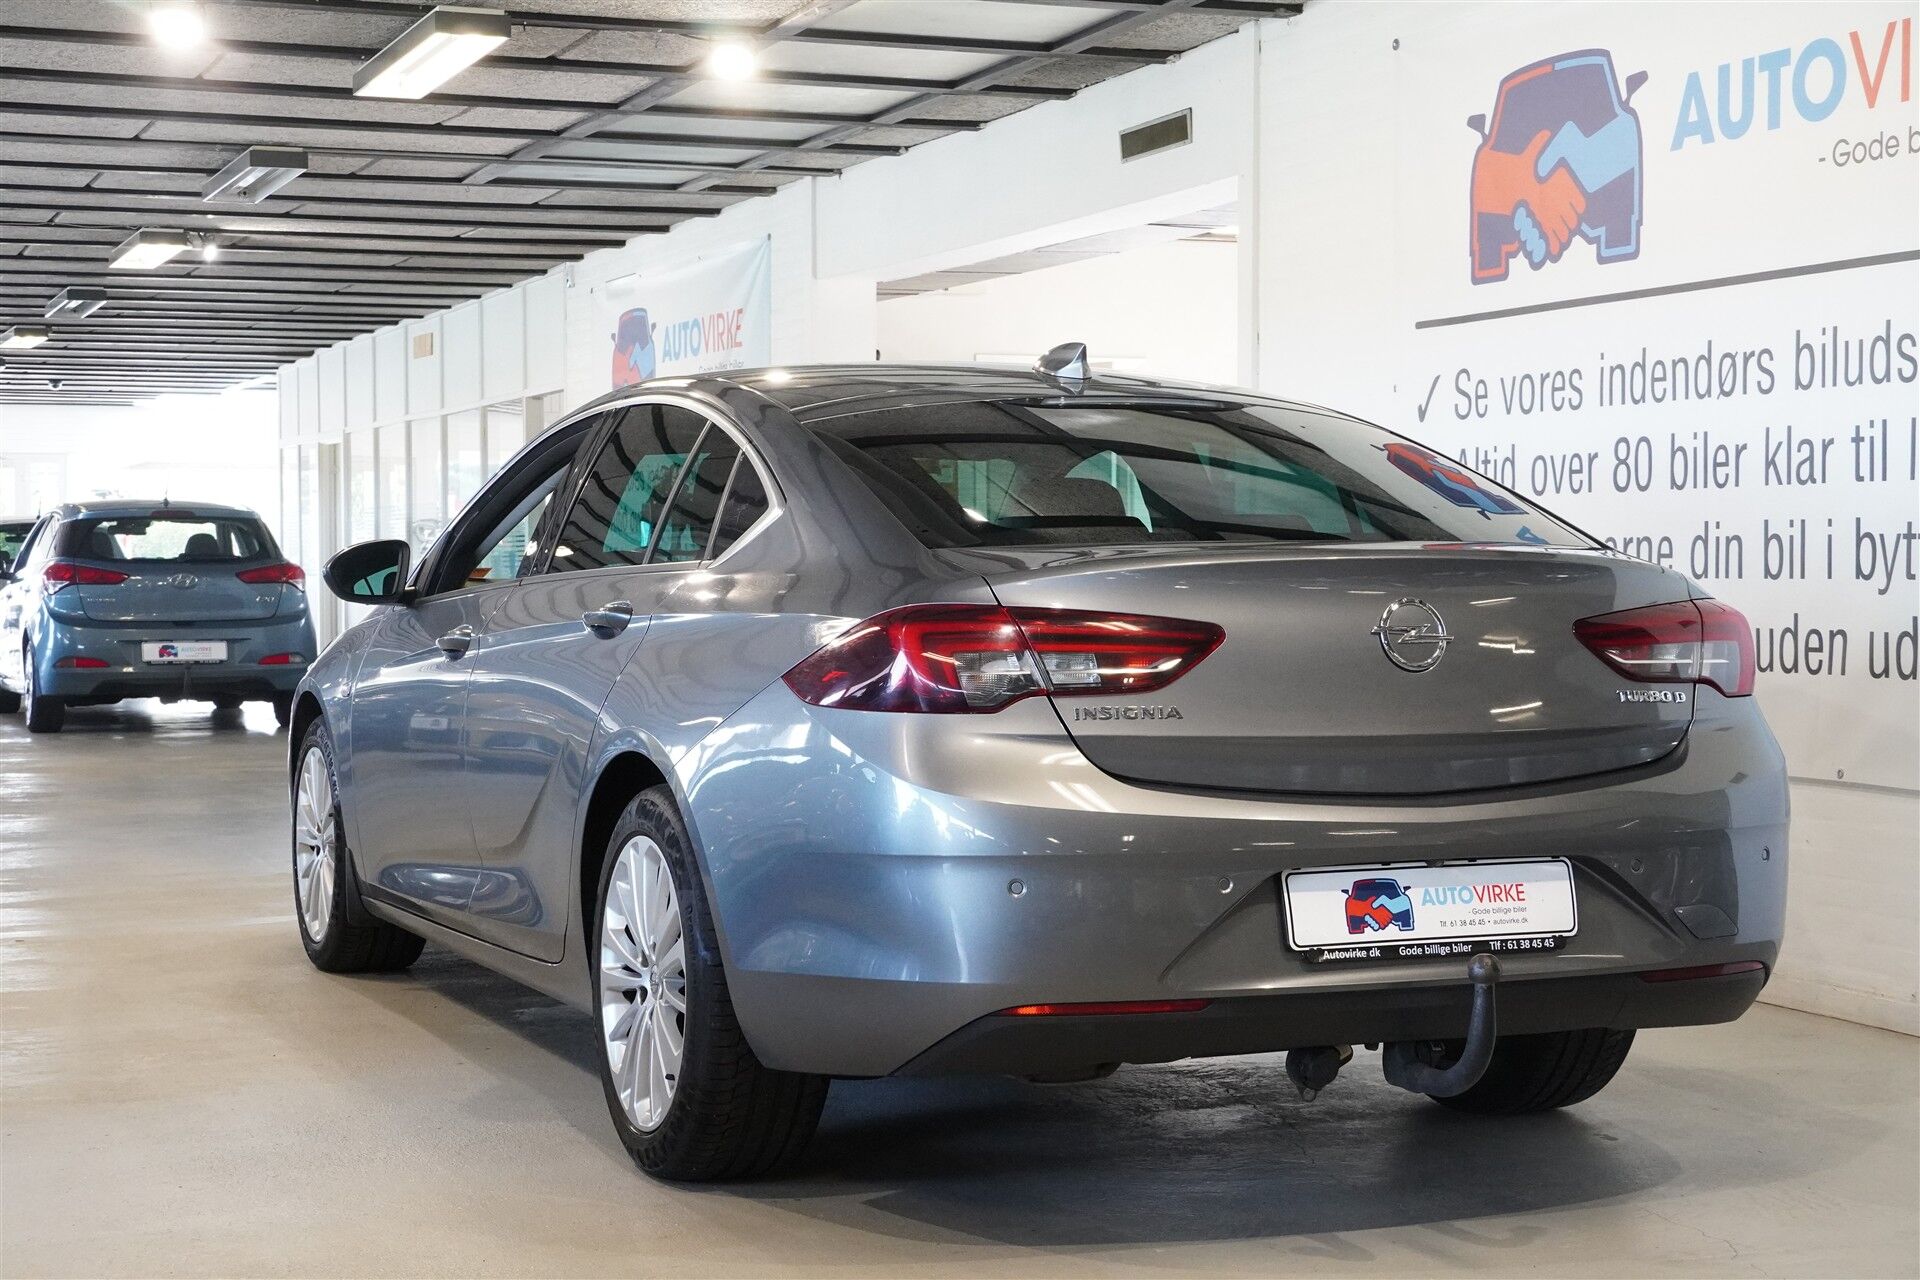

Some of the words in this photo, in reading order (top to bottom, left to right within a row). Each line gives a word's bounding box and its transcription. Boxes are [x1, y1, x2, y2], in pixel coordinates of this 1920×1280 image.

[1670, 17, 1911, 151] AUTOVI
[1832, 131, 1900, 167] Gode
[662, 308, 743, 363] AUTOVIRKE
[1454, 368, 1488, 420] Se
[1500, 368, 1583, 415] vores
[1599, 340, 1775, 406] indendørs
[1794, 319, 1918, 391] biluds
[1531, 451, 1598, 496] over
[1613, 436, 1653, 493] 80
[1670, 431, 1747, 491] biler
[1764, 425, 1834, 487] klar
[1850, 419, 1888, 483] til
[1690, 520, 1743, 580] din
[1763, 519, 1806, 580] bil
[1827, 518, 1833, 580] i
[1855, 517, 1920, 595] byt
[1756, 613, 1848, 676] uden
[1868, 616, 1918, 680] ud
[1074, 705, 1184, 721] INSIGNIA
[1616, 690, 1672, 703] TURBO
[1674, 691, 1687, 703] D
[1421, 883, 1526, 906] AUTOVIRKE
[1472, 907, 1491, 915] Gode
[1492, 906, 1512, 915] billige
[1513, 906, 1527, 914] biler
[1450, 919, 1458, 927] 61
[1459, 919, 1468, 927] 38
[1478, 918, 1486, 926] 45
[1323, 948, 1367, 960] Autovirke
[1369, 947, 1381, 957] dk
[1399, 945, 1423, 956] Gode
[1424, 944, 1451, 956] billige
[1452, 943, 1472, 953] biler
[1489, 941, 1501, 951] Tlf
[1507, 940, 1518, 950] 61
[1520, 939, 1531, 949] 38
[1532, 939, 1543, 948] 45
[1544, 938, 1555, 948] 45
